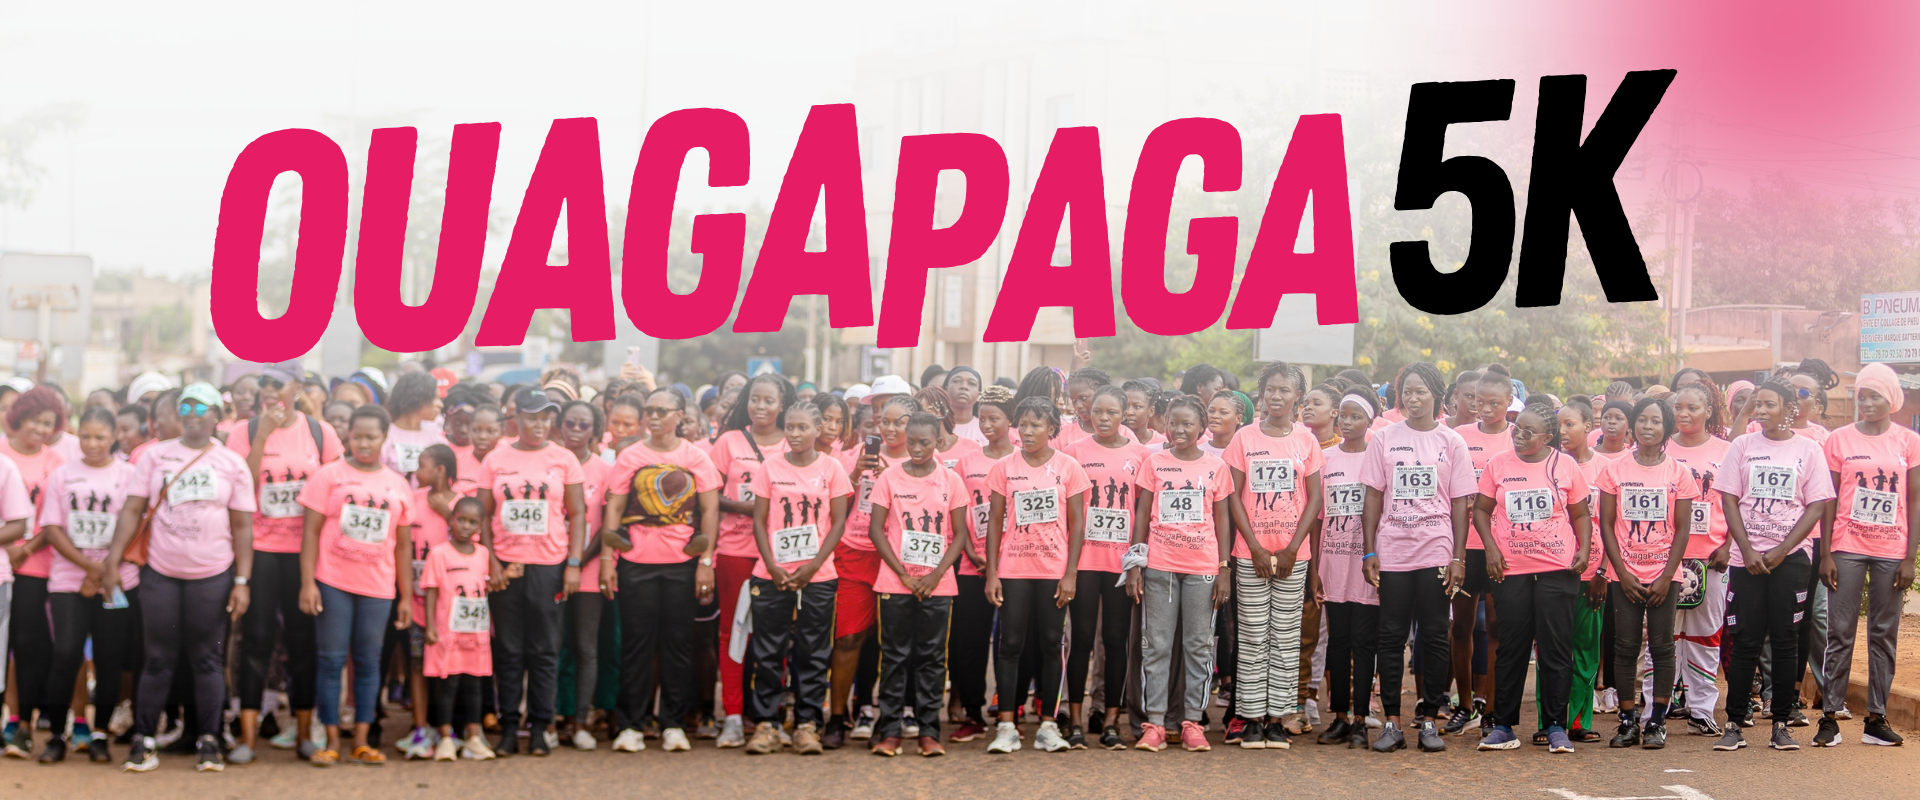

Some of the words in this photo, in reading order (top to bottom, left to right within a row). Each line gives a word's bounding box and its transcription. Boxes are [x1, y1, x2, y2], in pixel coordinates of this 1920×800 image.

[1881, 318, 1900, 326] COLLAGE
[1901, 318, 1907, 326] DE
[1884, 334, 1902, 342] MARQUE
[1255, 466, 1288, 480] 173
[1399, 473, 1432, 487] 163
[1757, 471, 1791, 487] 167
[1022, 495, 1054, 512] 325
[1330, 489, 1362, 504] 175
[1513, 495, 1547, 511] 116
[1628, 494, 1660, 508] 161
[1170, 497, 1192, 511] 48
[1860, 496, 1892, 513] 176
[509, 508, 542, 521] 346
[75, 519, 109, 536] 337
[349, 513, 383, 531] 343
[1093, 515, 1126, 530] 373
[1252, 521, 1298, 530] uagaPaga5
[780, 533, 811, 549] 377
[909, 538, 941, 555] 375
[1322, 541, 1364, 550] OuagaPaga
[1508, 540, 1565, 550] OuagaPaga5K
[1623, 550, 1670, 560] OuagaPaga
